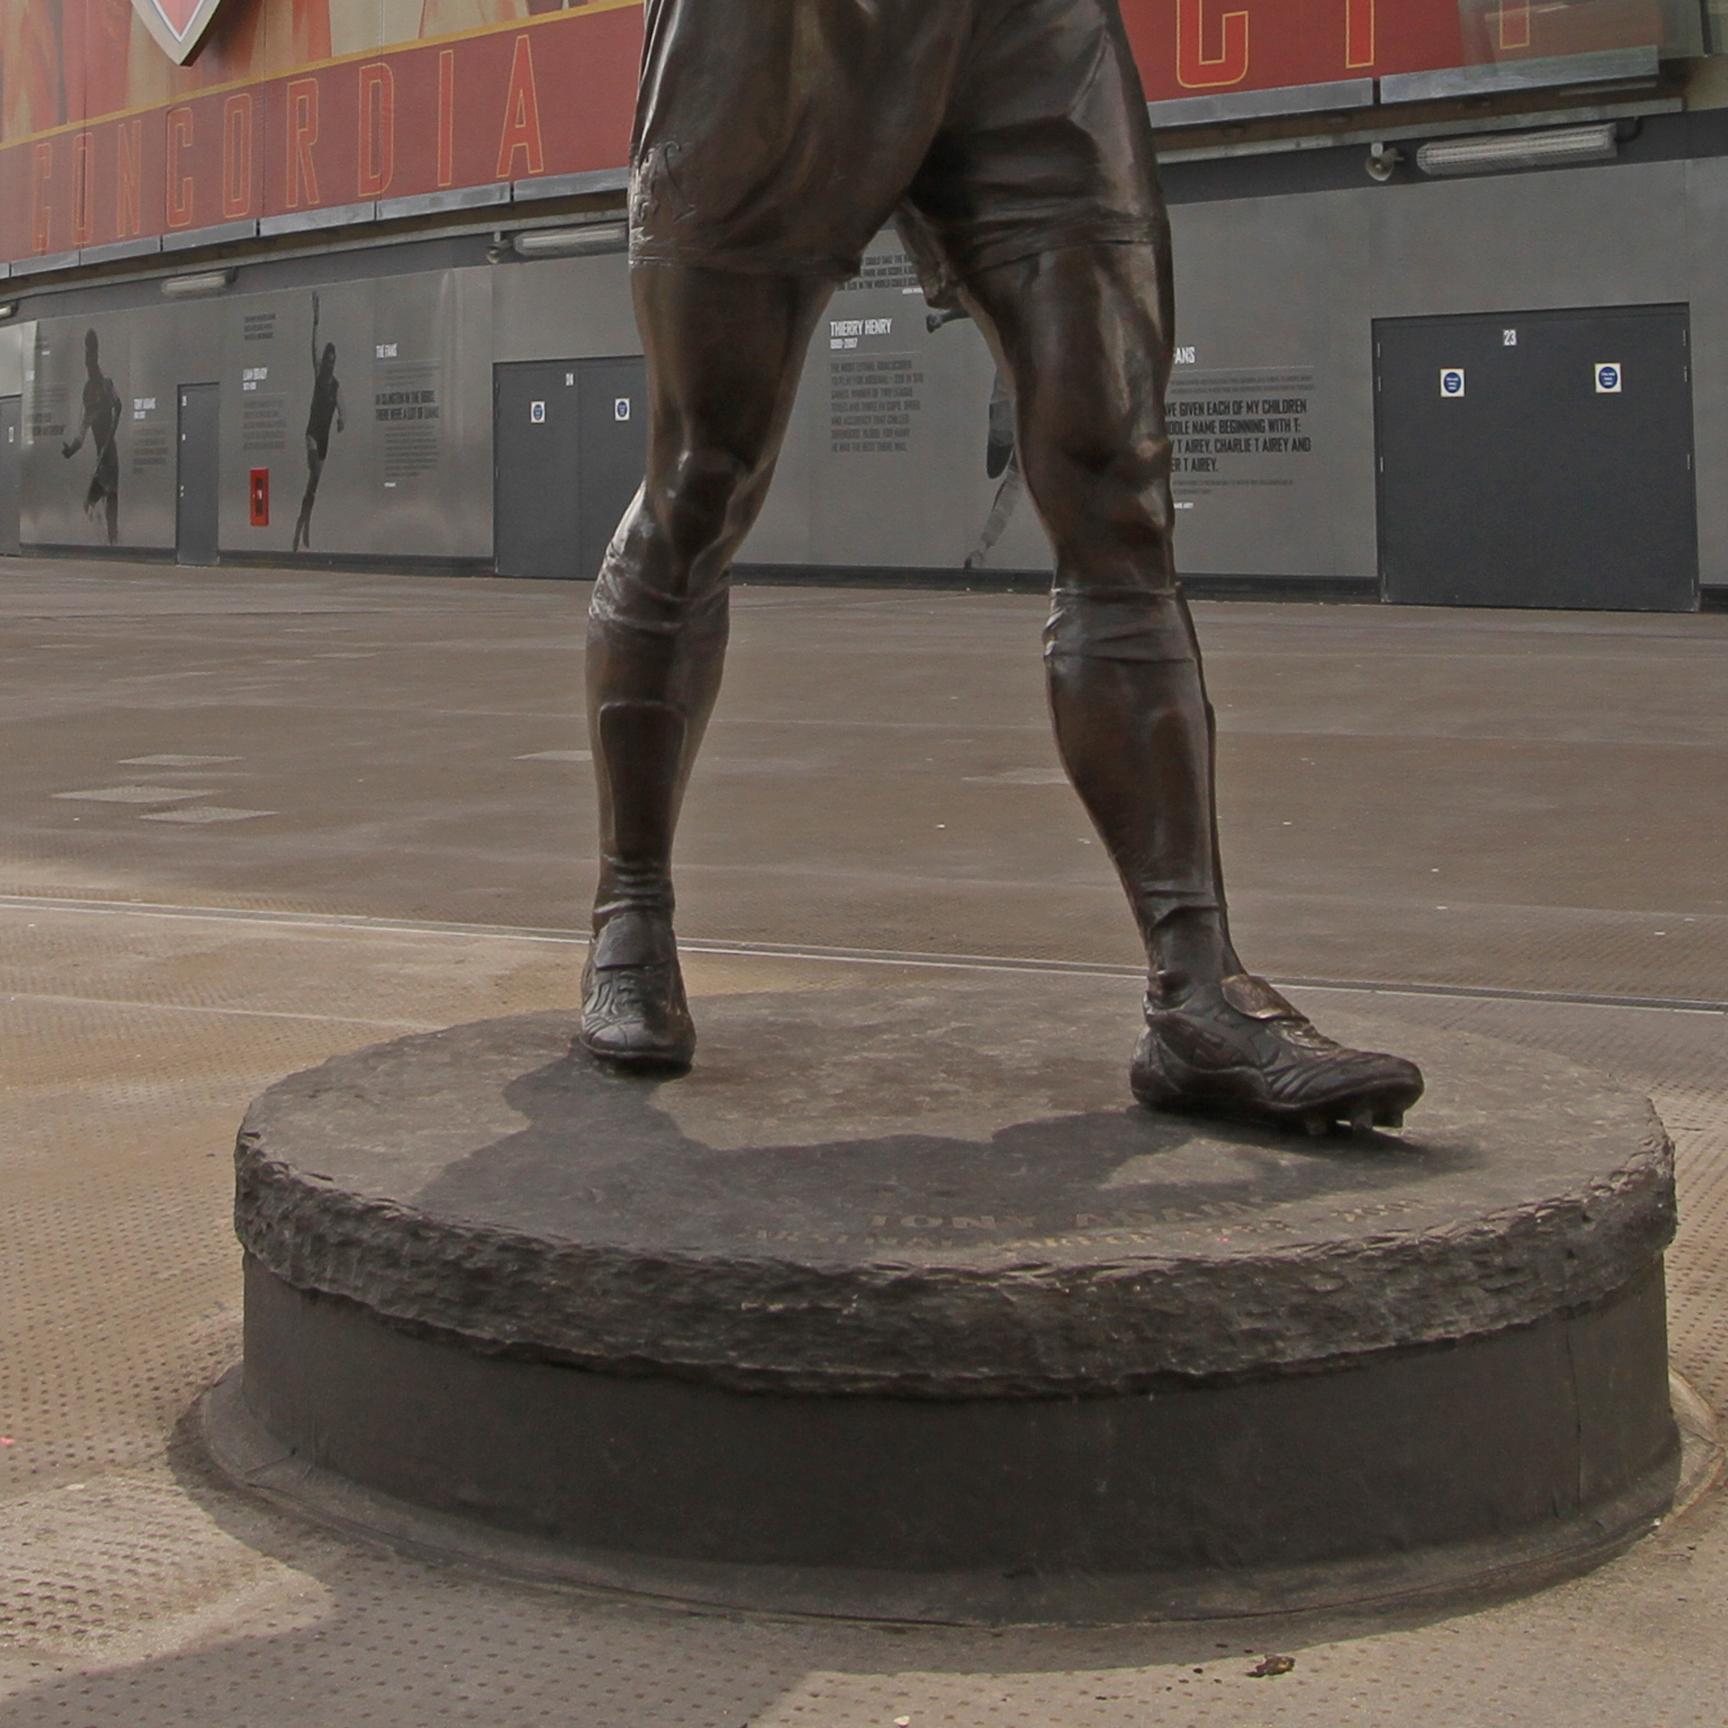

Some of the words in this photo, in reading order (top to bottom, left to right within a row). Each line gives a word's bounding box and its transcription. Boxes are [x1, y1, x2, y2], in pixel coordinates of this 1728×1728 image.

[32, 34, 545, 253] CONCORDIA
[830, 320, 864, 337] THIERRY
[865, 318, 892, 335] HENRY
[1503, 329, 1517, 346] 23
[1174, 346, 1196, 364] ANS
[1179, 400, 1205, 417] GIVEN
[1207, 399, 1230, 416] EACH
[1232, 399, 1244, 415] OF
[1246, 399, 1260, 415] MY
[1262, 397, 1307, 414] CHILDREN
[1192, 419, 1216, 436] NAME
[1219, 417, 1265, 435] BEGINNING
[1267, 417, 1291, 433] WITH
[1214, 437, 1251, 454] CHARLIE
[1261, 436, 1288, 453] AIREY
[1290, 435, 1312, 452] AND
[1183, 457, 1189, 473] T
